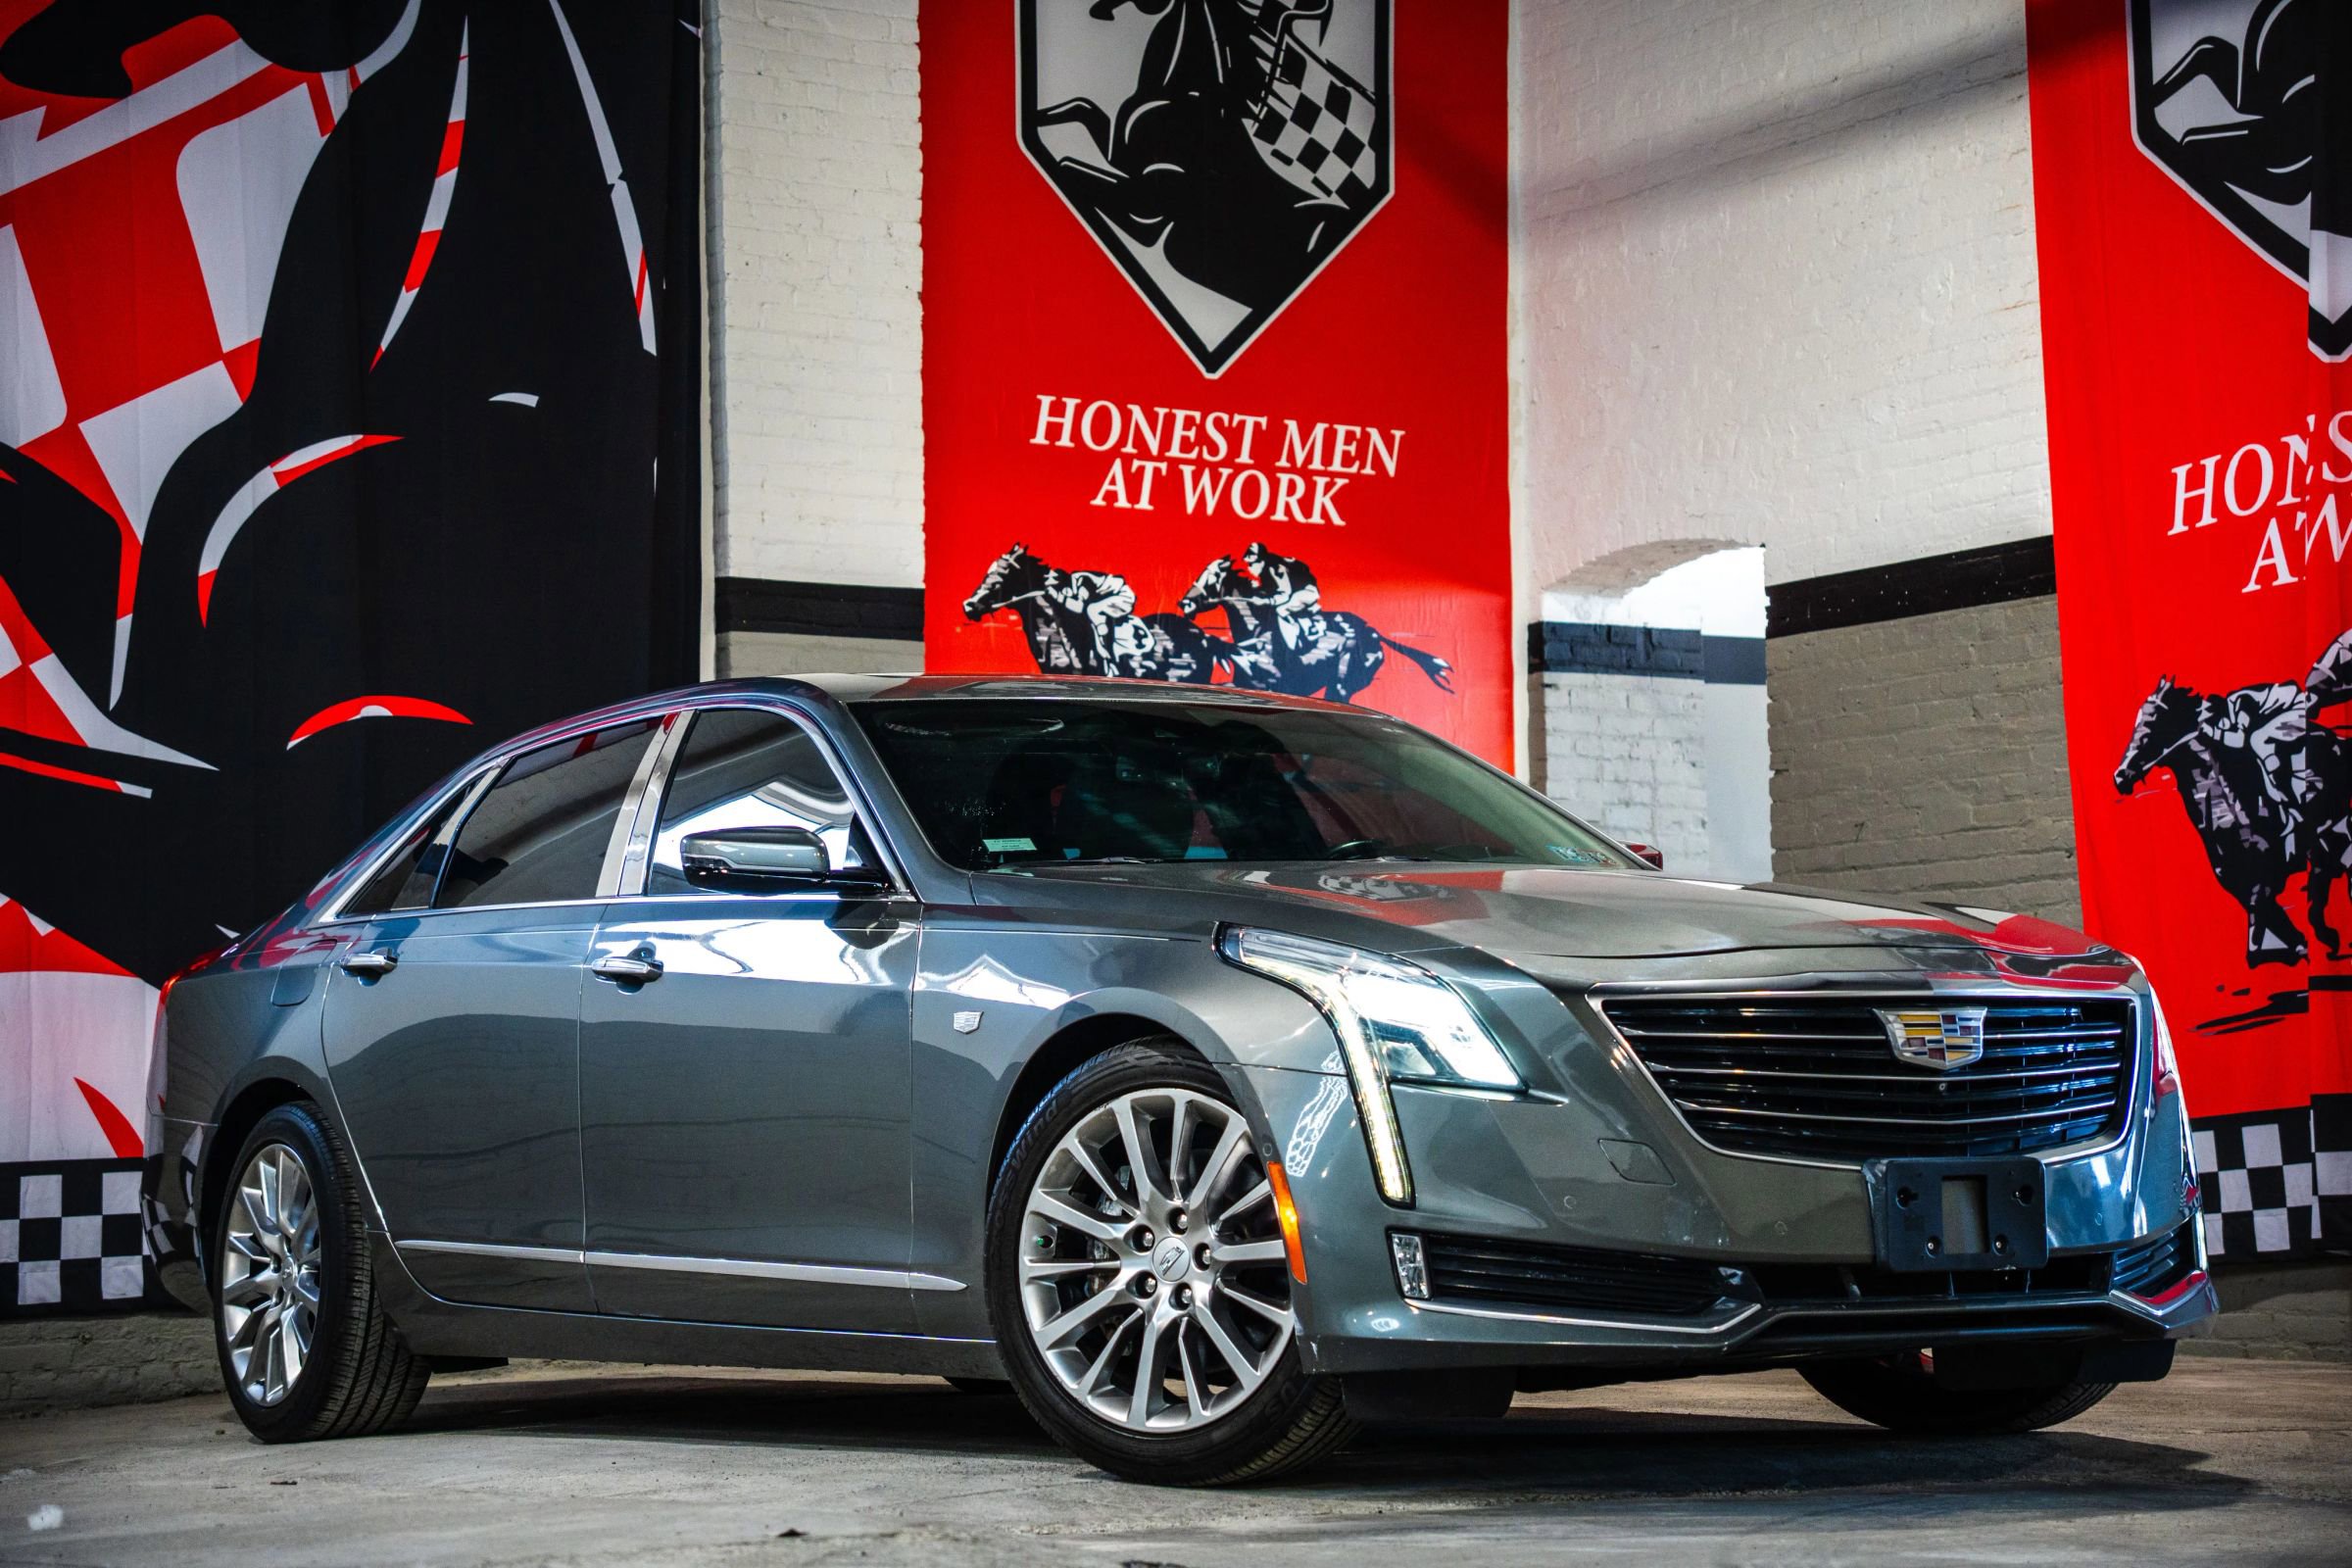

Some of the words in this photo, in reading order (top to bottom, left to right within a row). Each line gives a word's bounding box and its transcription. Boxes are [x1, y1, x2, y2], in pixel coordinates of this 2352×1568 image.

[1029, 394, 1268, 465] HONEST
[1275, 419, 1405, 477] MEN
[2167, 411, 2352, 536] HONS
[1090, 458, 1168, 511] AT
[1178, 464, 1349, 526] WORK
